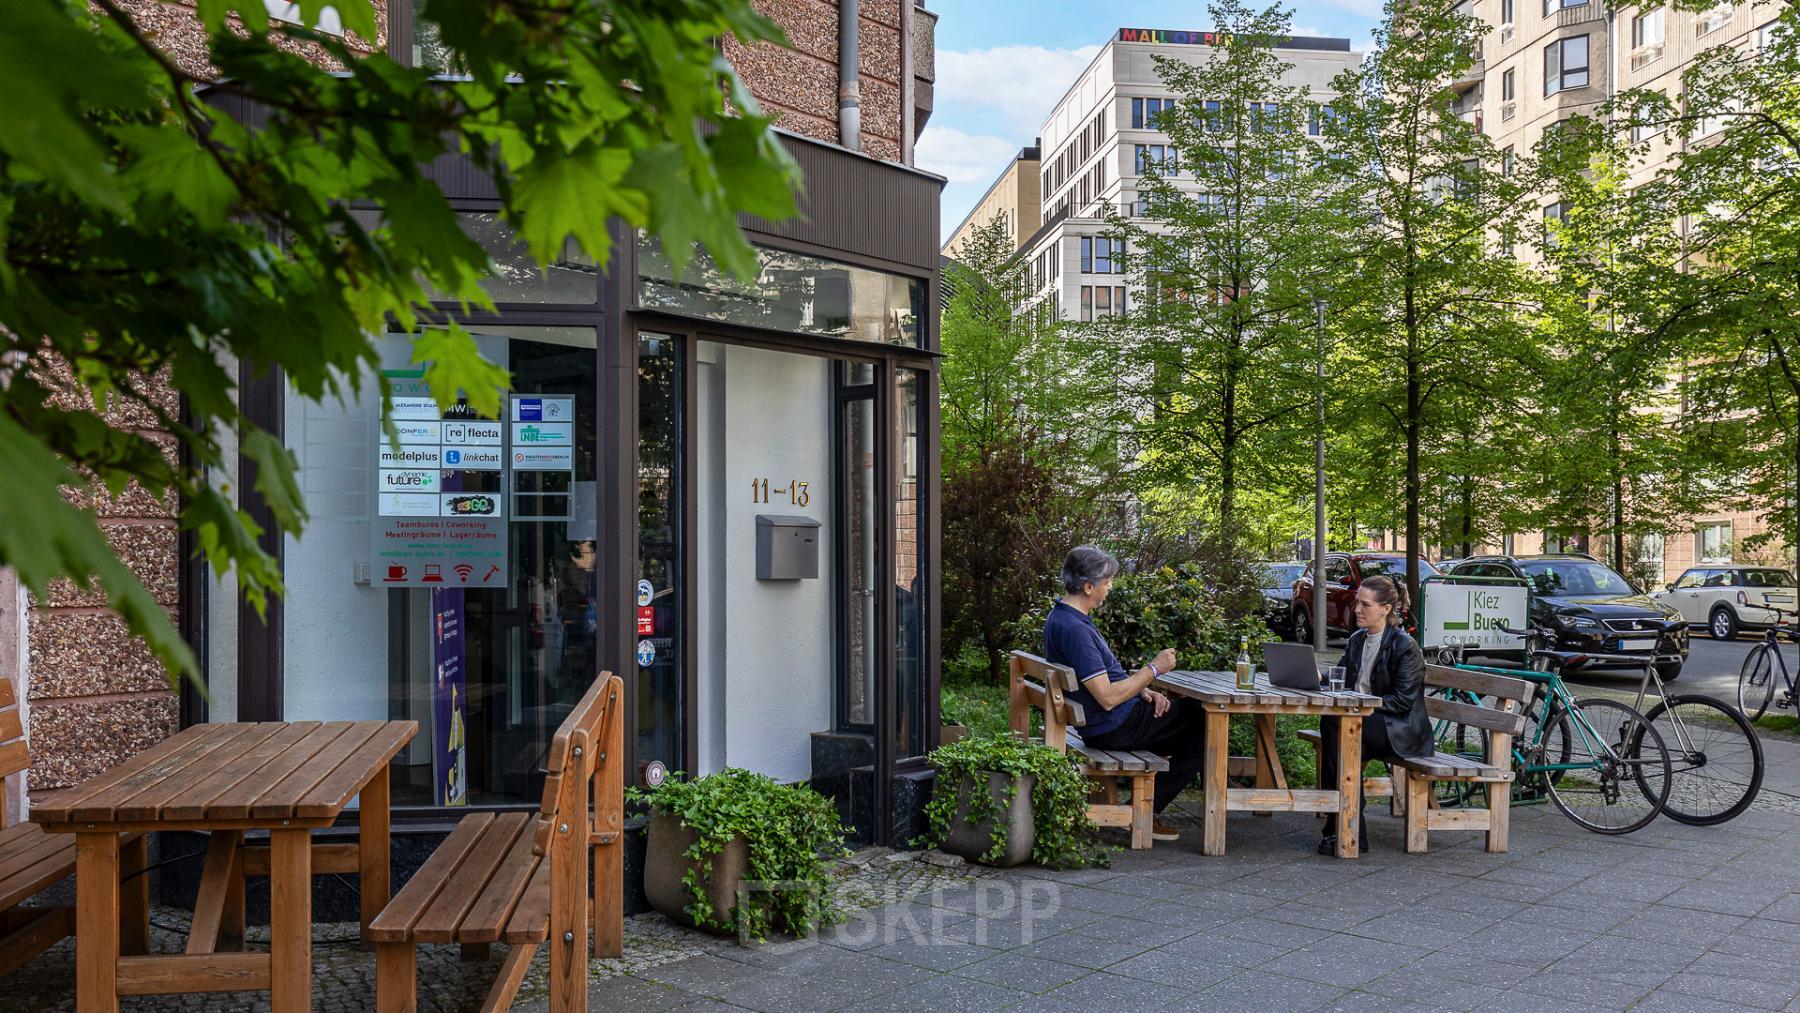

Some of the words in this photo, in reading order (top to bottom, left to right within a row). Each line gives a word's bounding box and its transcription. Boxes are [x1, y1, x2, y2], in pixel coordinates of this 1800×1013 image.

[1122, 28, 1167, 44] MALL
[1173, 31, 1198, 43] OF
[468, 427, 499, 438] flecta
[382, 451, 438, 463] modelplus
[463, 453, 499, 462] linkchat
[387, 473, 422, 485] future
[1473, 591, 1500, 609] Kiez
[1443, 635, 1509, 645] COWORKING
